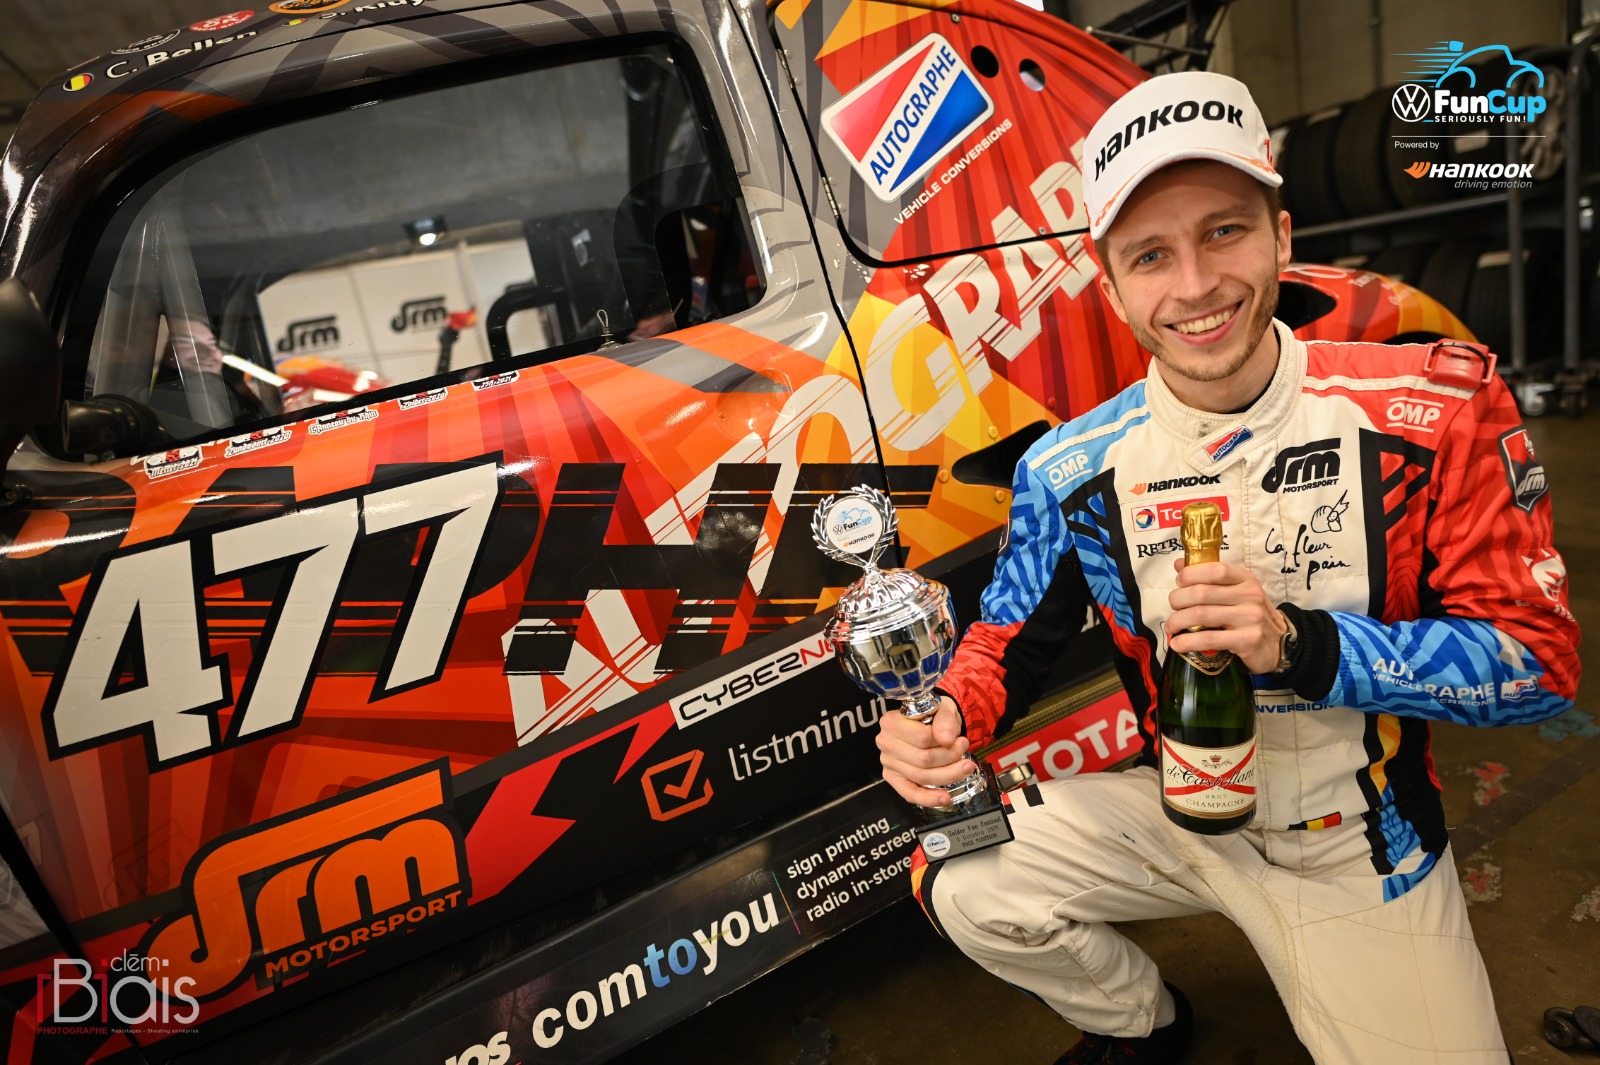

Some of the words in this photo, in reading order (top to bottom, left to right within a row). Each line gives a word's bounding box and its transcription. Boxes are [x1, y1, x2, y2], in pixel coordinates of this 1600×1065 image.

[146, 30, 258, 67] Bollen
[869, 45, 957, 186] AUTOGRAPHE
[894, 182, 941, 226] VEHICLE
[940, 119, 1013, 184] CONVERSIONS
[1386, 402, 1441, 426] OMP
[1048, 454, 1089, 485] OMP
[1283, 478, 1339, 494] MOTORSPORT
[1136, 538, 1184, 558] RETR
[50, 460, 499, 764] 477
[998, 709, 1138, 785] TOTA
[1179, 764, 1256, 787] Castellan
[1185, 797, 1245, 808] CHAMPAGNE
[787, 852, 823, 879] sign
[825, 817, 890, 862] printing
[797, 854, 869, 899] dynamic
[806, 890, 850, 922] radio
[850, 856, 912, 897] in-store
[265, 890, 462, 978] MOTORSPORT
[532, 892, 780, 1049] comtoyou
